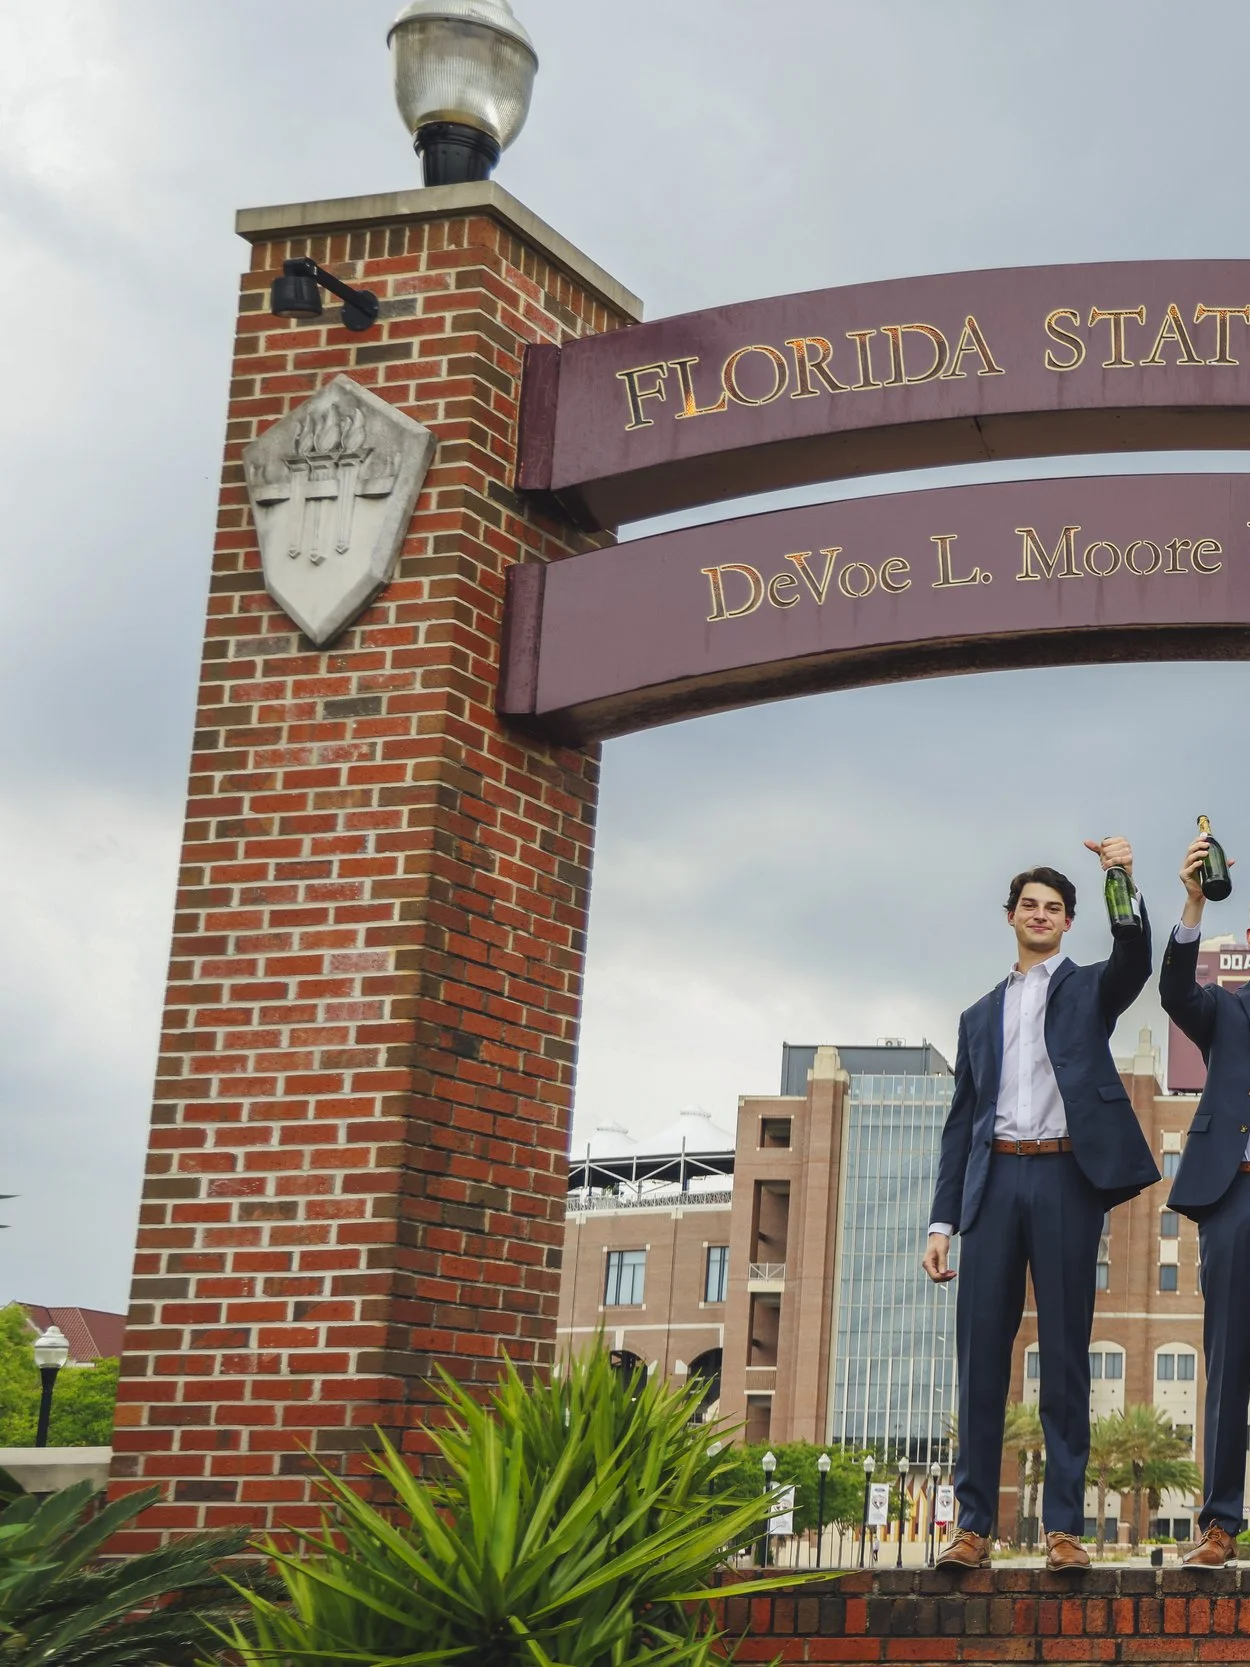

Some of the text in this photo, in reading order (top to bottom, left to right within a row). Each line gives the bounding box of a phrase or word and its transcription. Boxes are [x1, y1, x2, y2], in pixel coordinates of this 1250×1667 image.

[616, 315, 1005, 431] FLORIDA
[701, 546, 911, 621] DeVoe
[930, 534, 993, 588] L.
[1014, 524, 1223, 582] Moore
